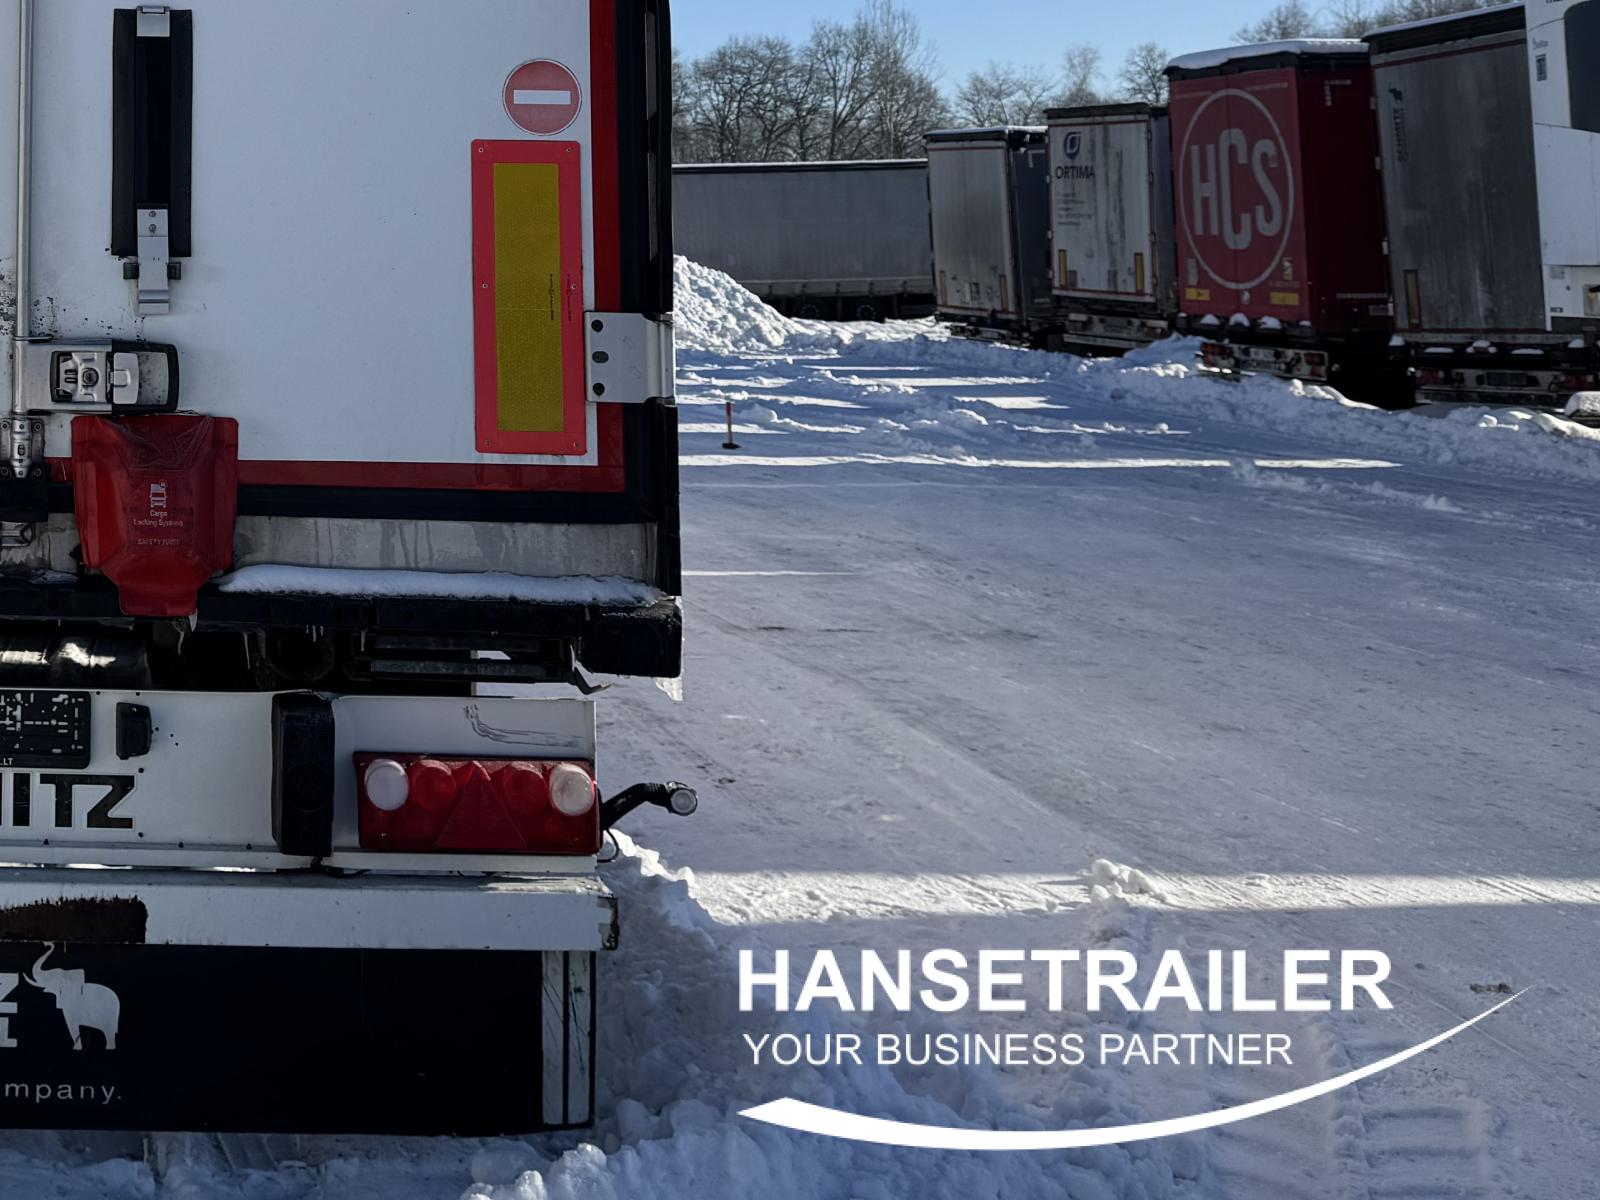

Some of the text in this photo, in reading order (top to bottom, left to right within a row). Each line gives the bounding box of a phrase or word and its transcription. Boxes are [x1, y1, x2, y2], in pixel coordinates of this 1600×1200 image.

[1055, 166, 1096, 180] ORTIMA
[1190, 128, 1283, 250] HCS
[150, 509, 168, 518] Cargo
